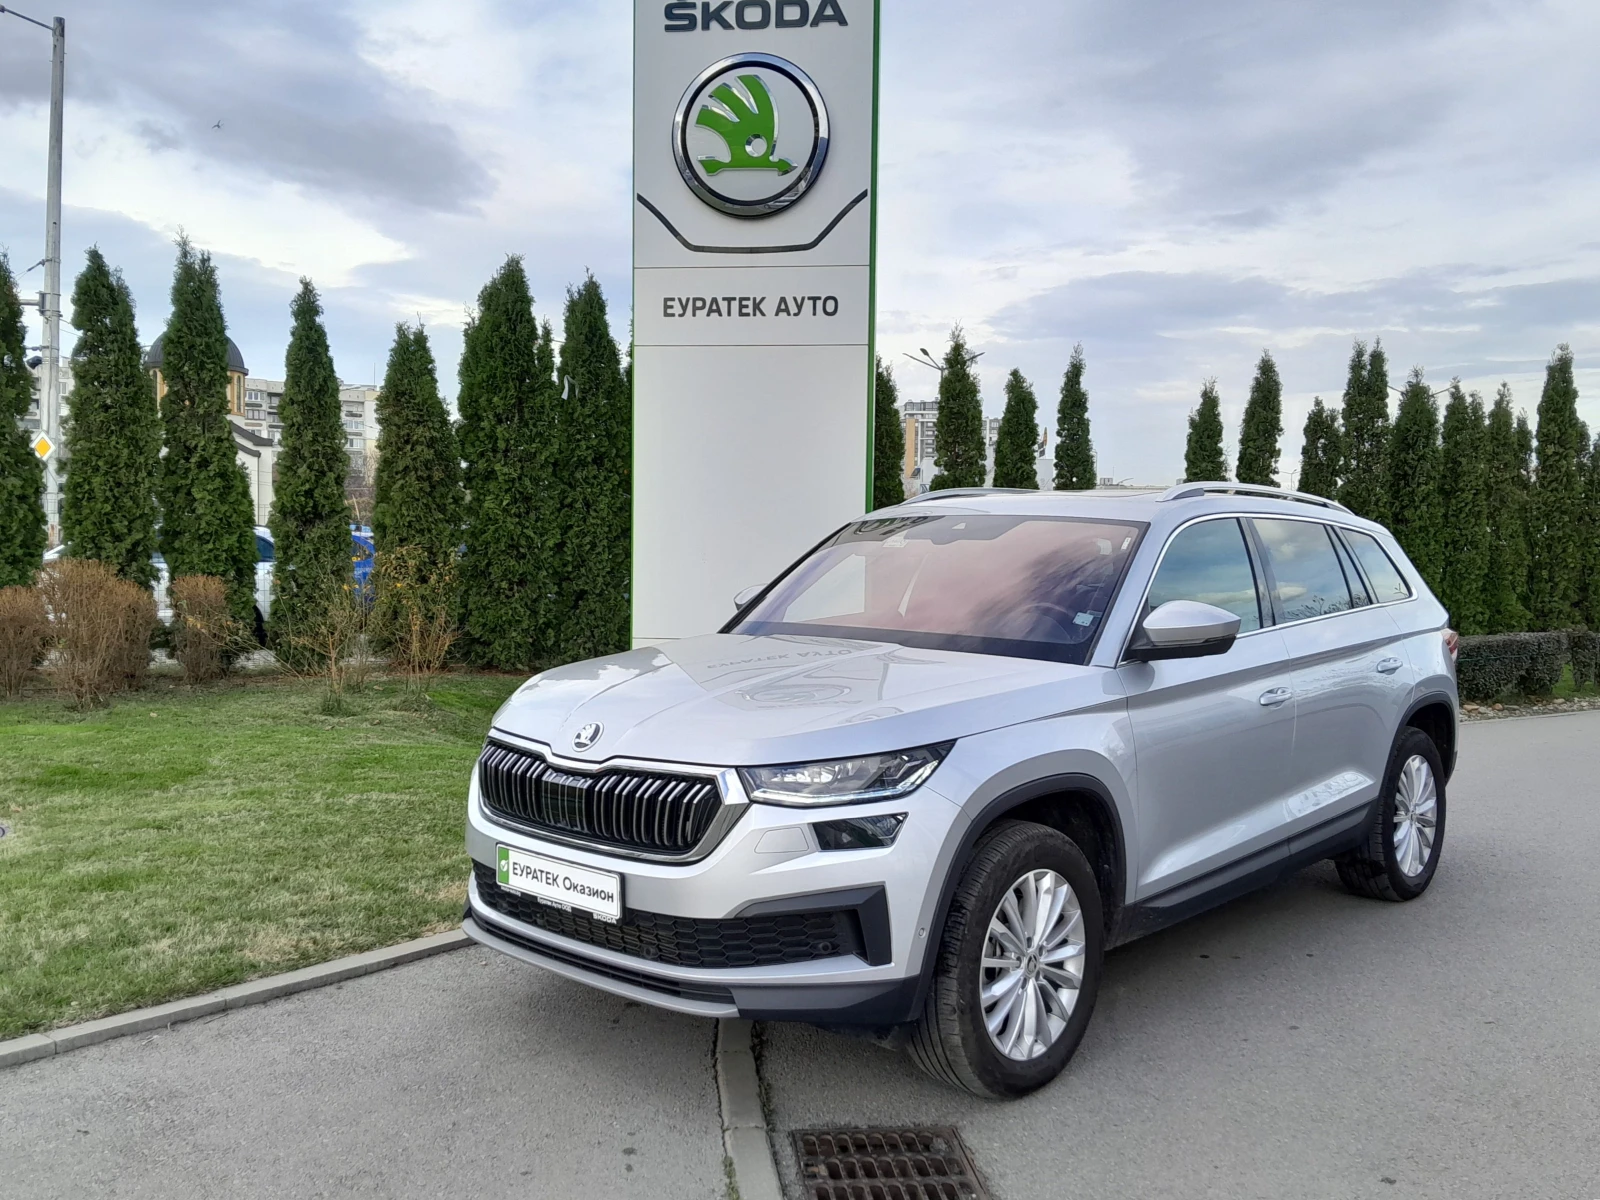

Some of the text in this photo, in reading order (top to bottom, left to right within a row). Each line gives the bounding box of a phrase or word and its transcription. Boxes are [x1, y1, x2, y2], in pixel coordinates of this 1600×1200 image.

[663, 296, 839, 318] ЕУРАТЕК АУТО
[512, 861, 614, 903] ЕУРАТЕК Оказион
